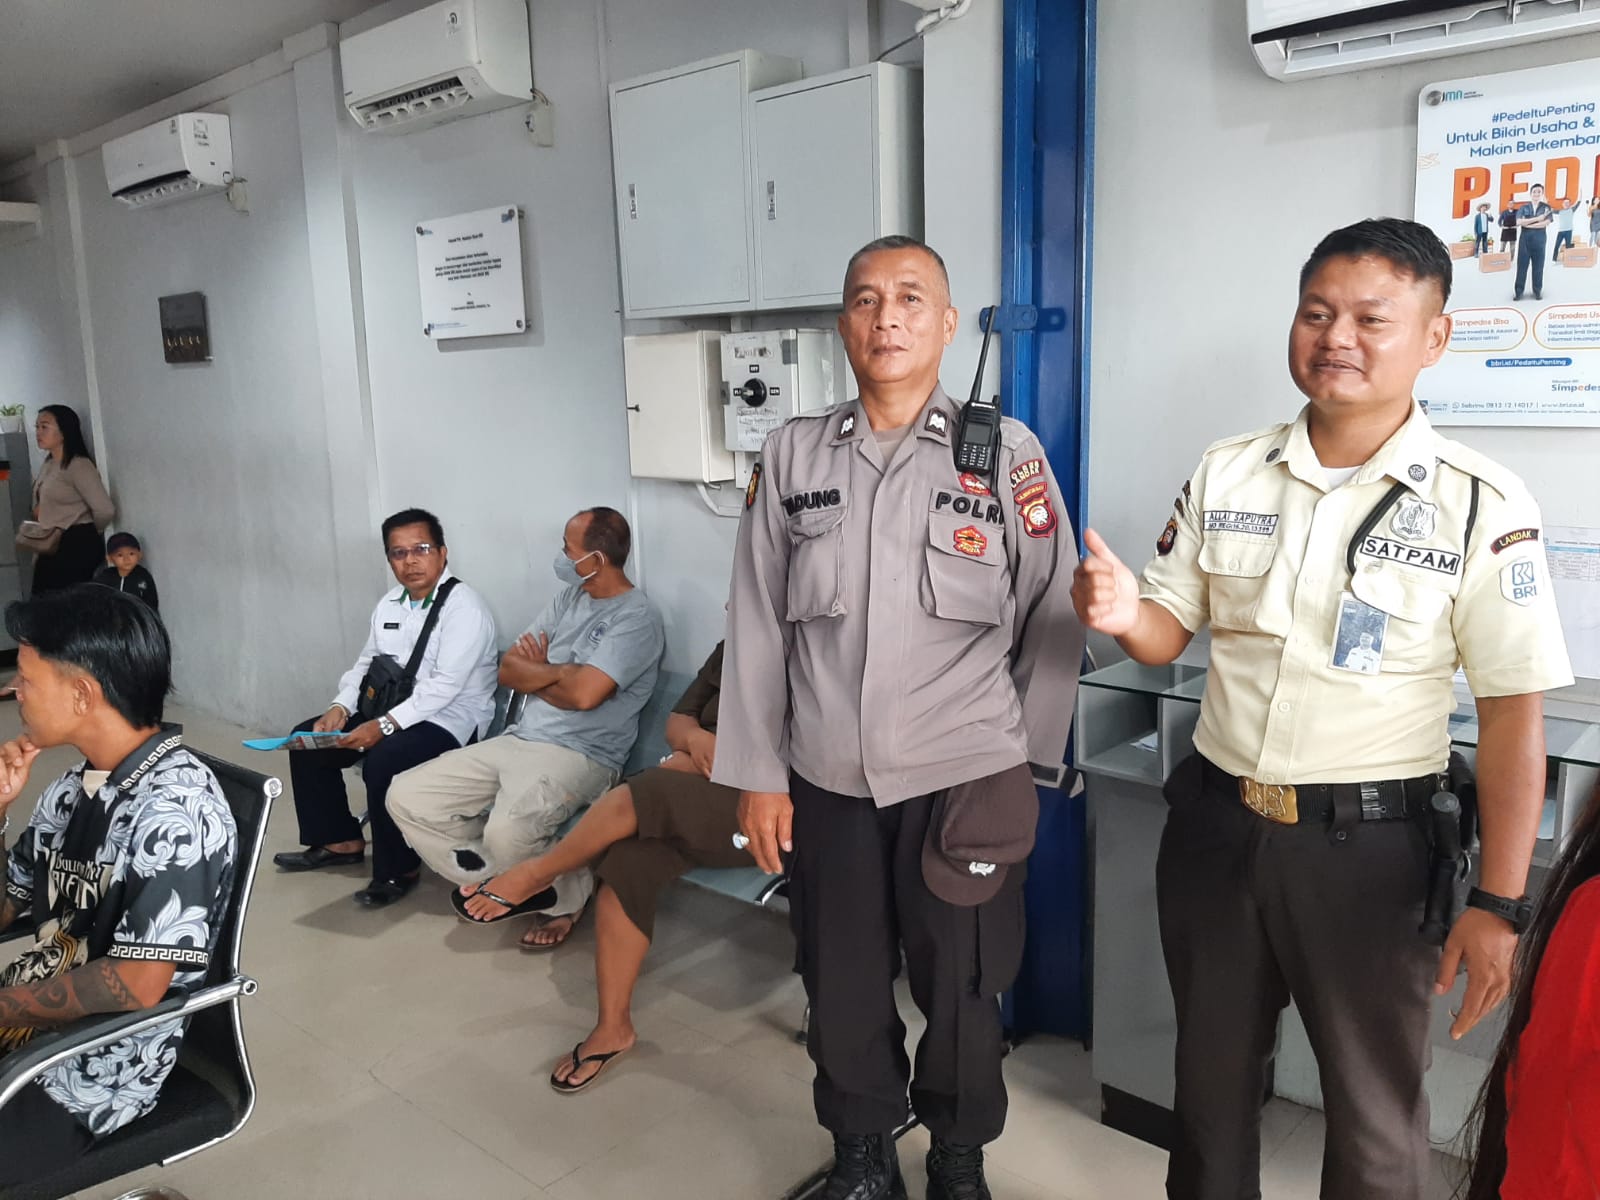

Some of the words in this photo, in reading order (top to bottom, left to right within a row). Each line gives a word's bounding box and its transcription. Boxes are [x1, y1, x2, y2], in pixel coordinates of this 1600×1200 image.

[1492, 102, 1595, 123] #PedeItuPenting
[1446, 129, 1488, 145] Untuk
[1492, 125, 1526, 140] Bikin
[1530, 118, 1578, 135] Usaha
[1583, 116, 1595, 128] &
[1470, 142, 1512, 158] Makin
[1234, 513, 1272, 526] SAPUTRA
[1499, 530, 1532, 547] LANDAK
[1365, 539, 1457, 572] SATPAM
[1513, 585, 1537, 600] BRI
